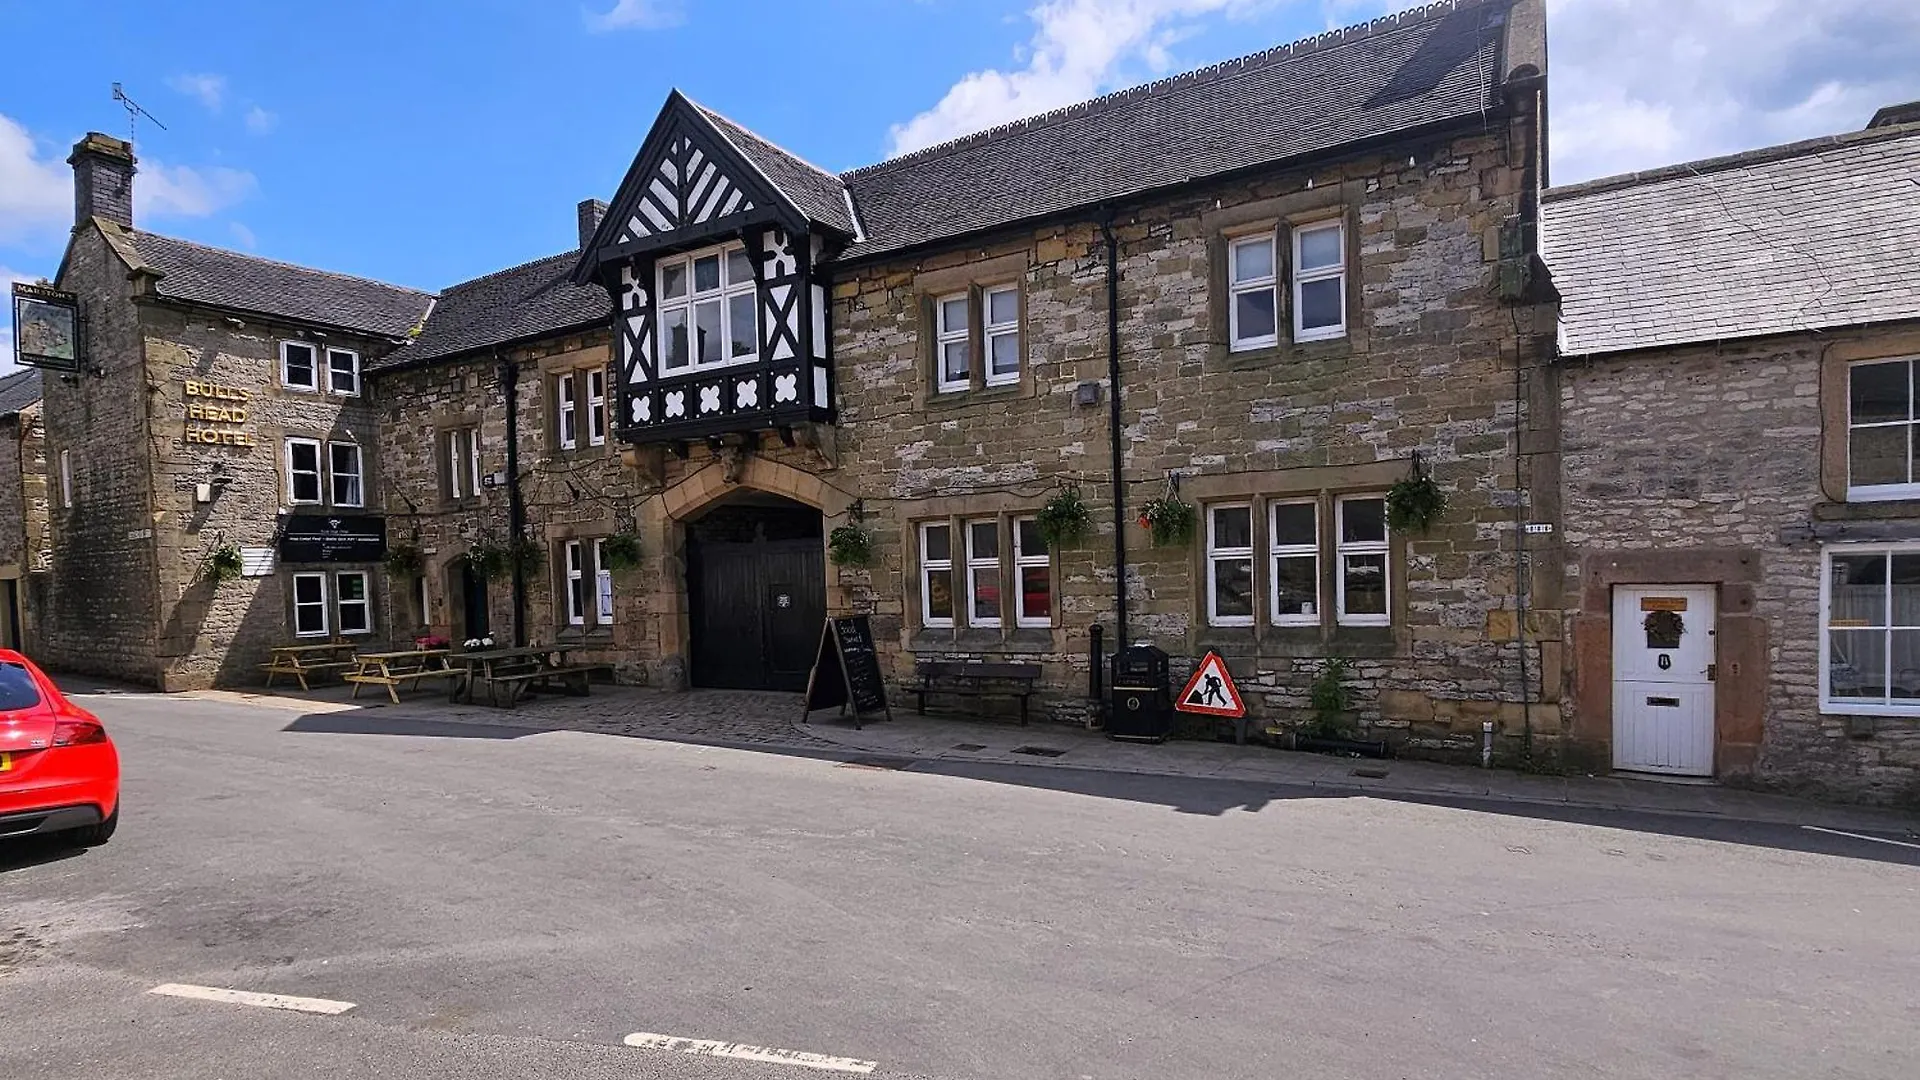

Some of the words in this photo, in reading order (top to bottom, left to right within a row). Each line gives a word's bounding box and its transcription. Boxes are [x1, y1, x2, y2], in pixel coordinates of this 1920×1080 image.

[185, 380, 252, 401] BULLS
[187, 403, 247, 423] HEAD
[186, 427, 257, 447] HOTEL
